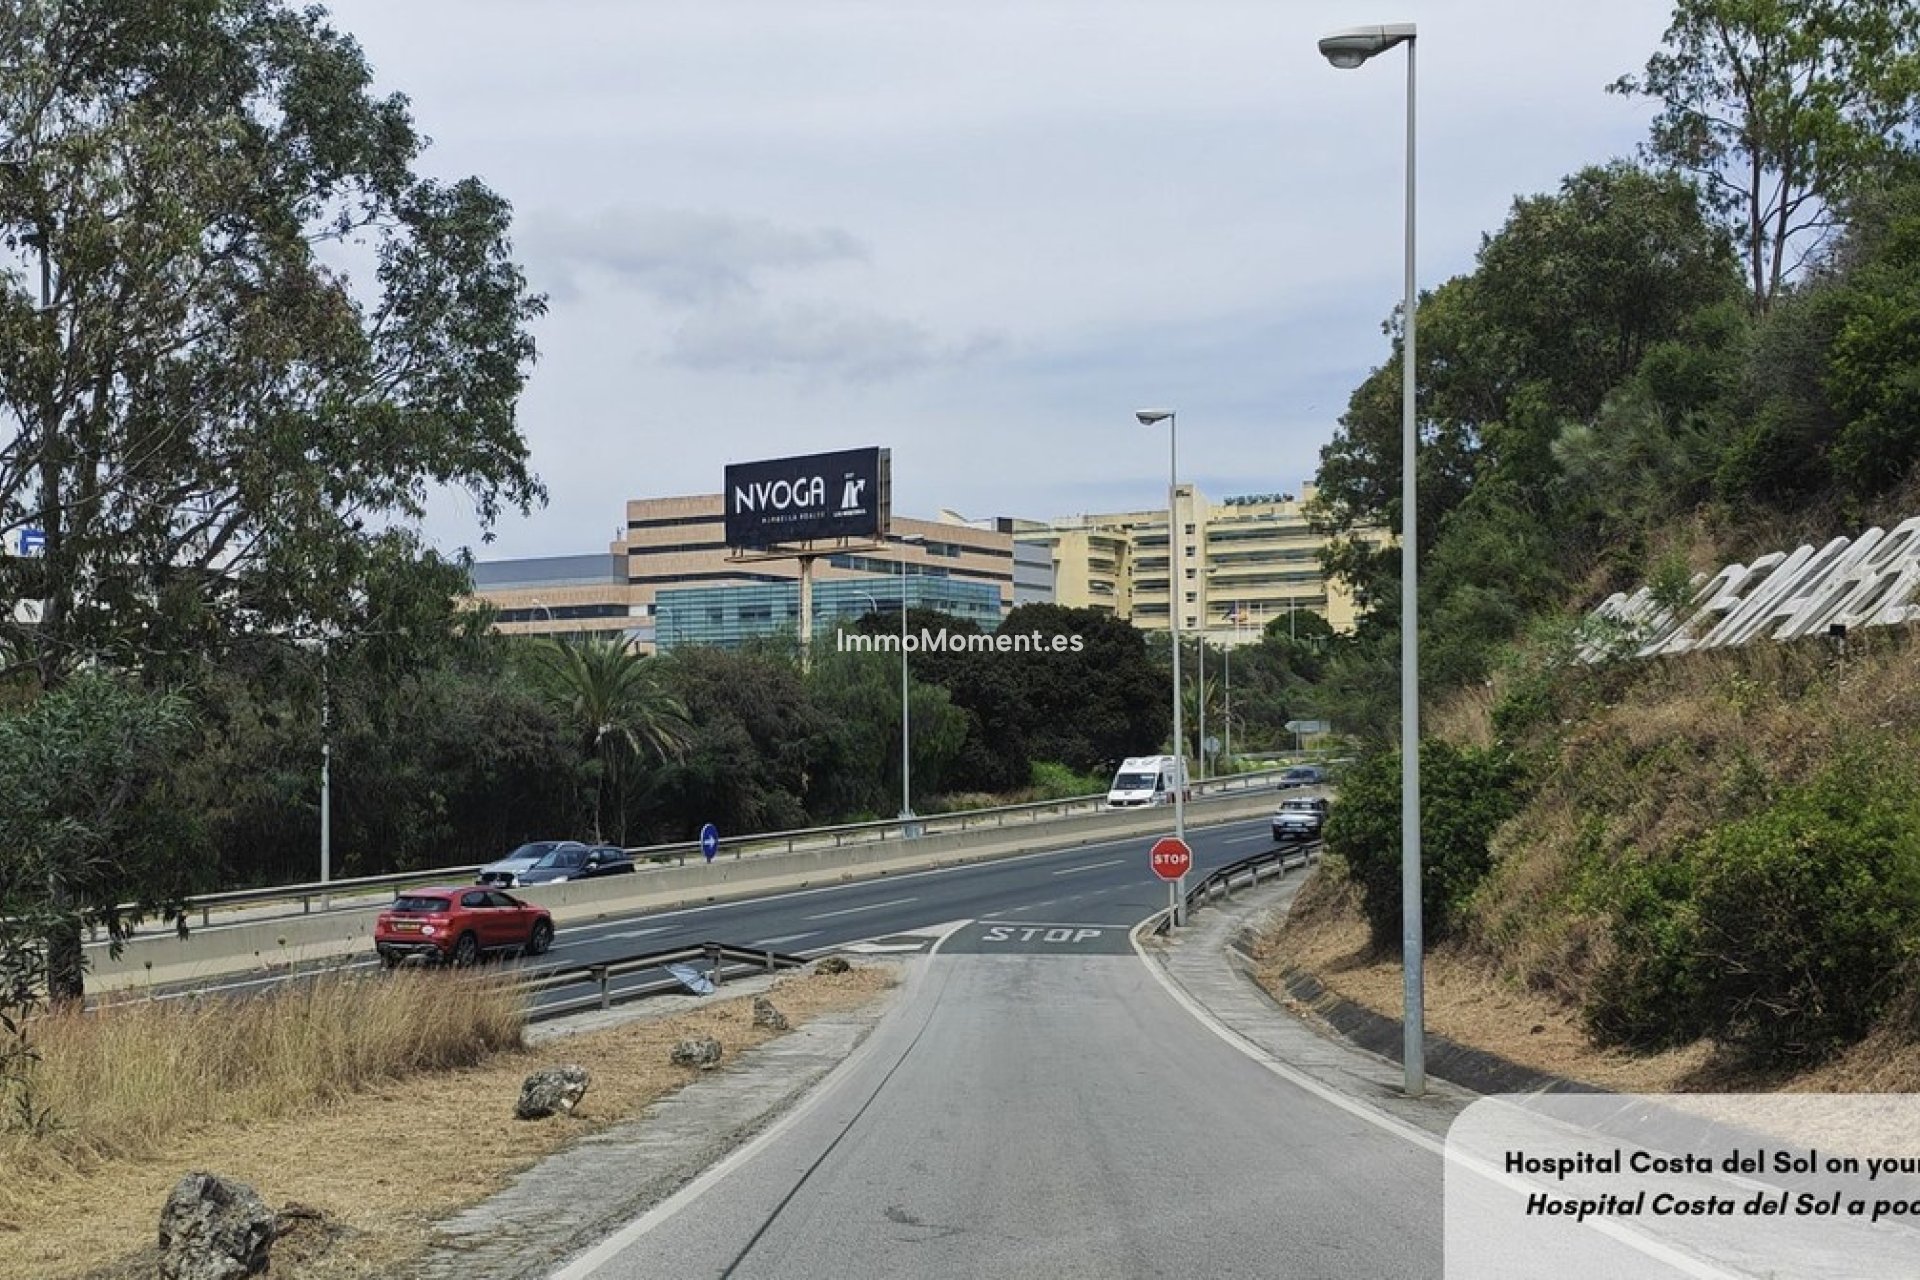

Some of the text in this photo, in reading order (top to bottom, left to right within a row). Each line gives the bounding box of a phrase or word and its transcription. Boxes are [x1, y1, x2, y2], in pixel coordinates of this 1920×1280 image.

[735, 476, 824, 514] NVOGA
[1154, 854, 1188, 865] STOP
[981, 926, 1102, 943] STOP
